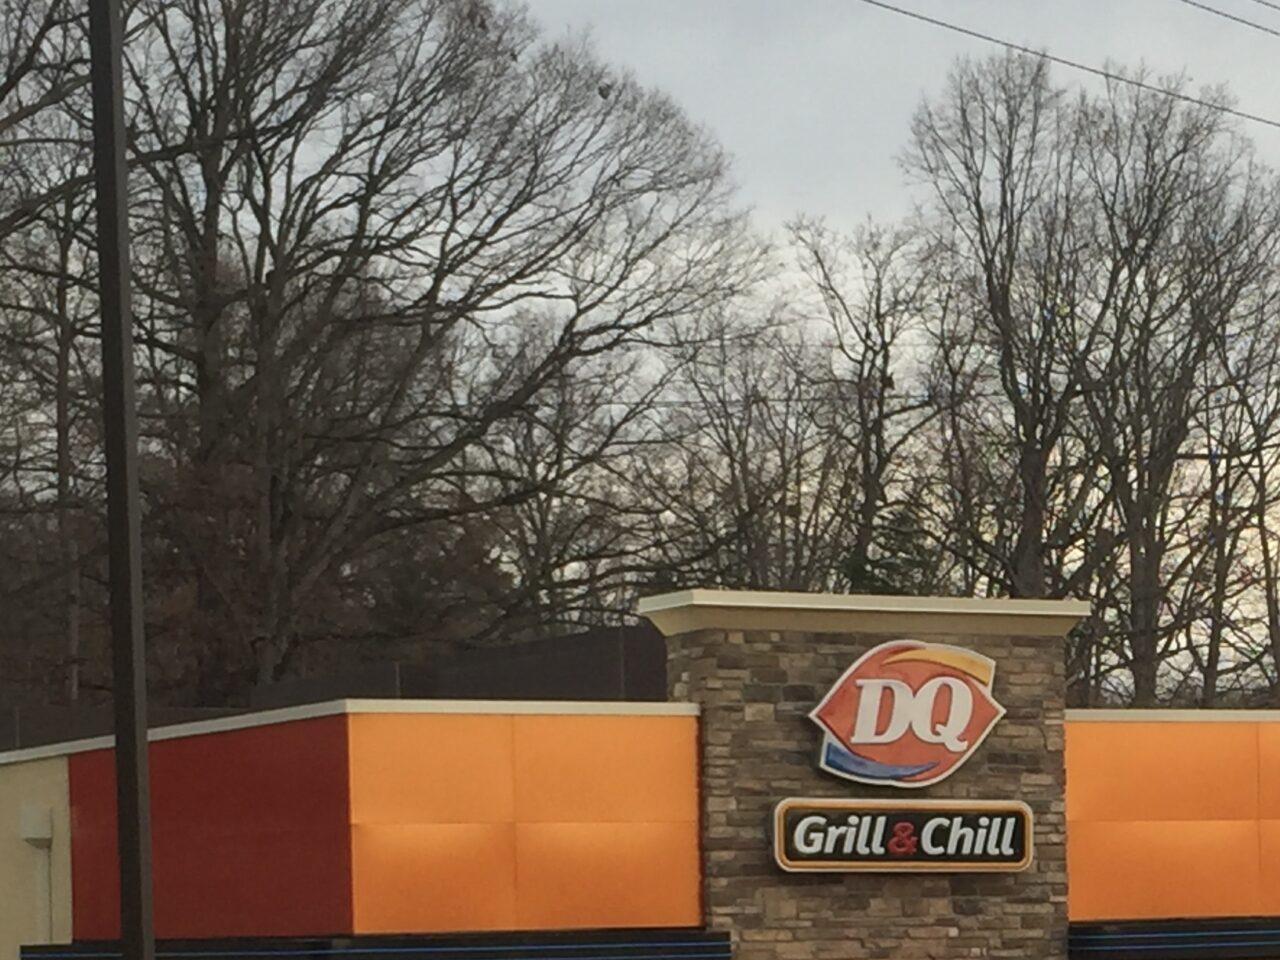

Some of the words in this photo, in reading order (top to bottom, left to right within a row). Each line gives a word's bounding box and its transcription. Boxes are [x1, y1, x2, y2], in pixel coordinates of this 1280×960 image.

[851, 676, 973, 752] DQ
[793, 816, 887, 855] Grill
[920, 817, 1016, 856] Chill
